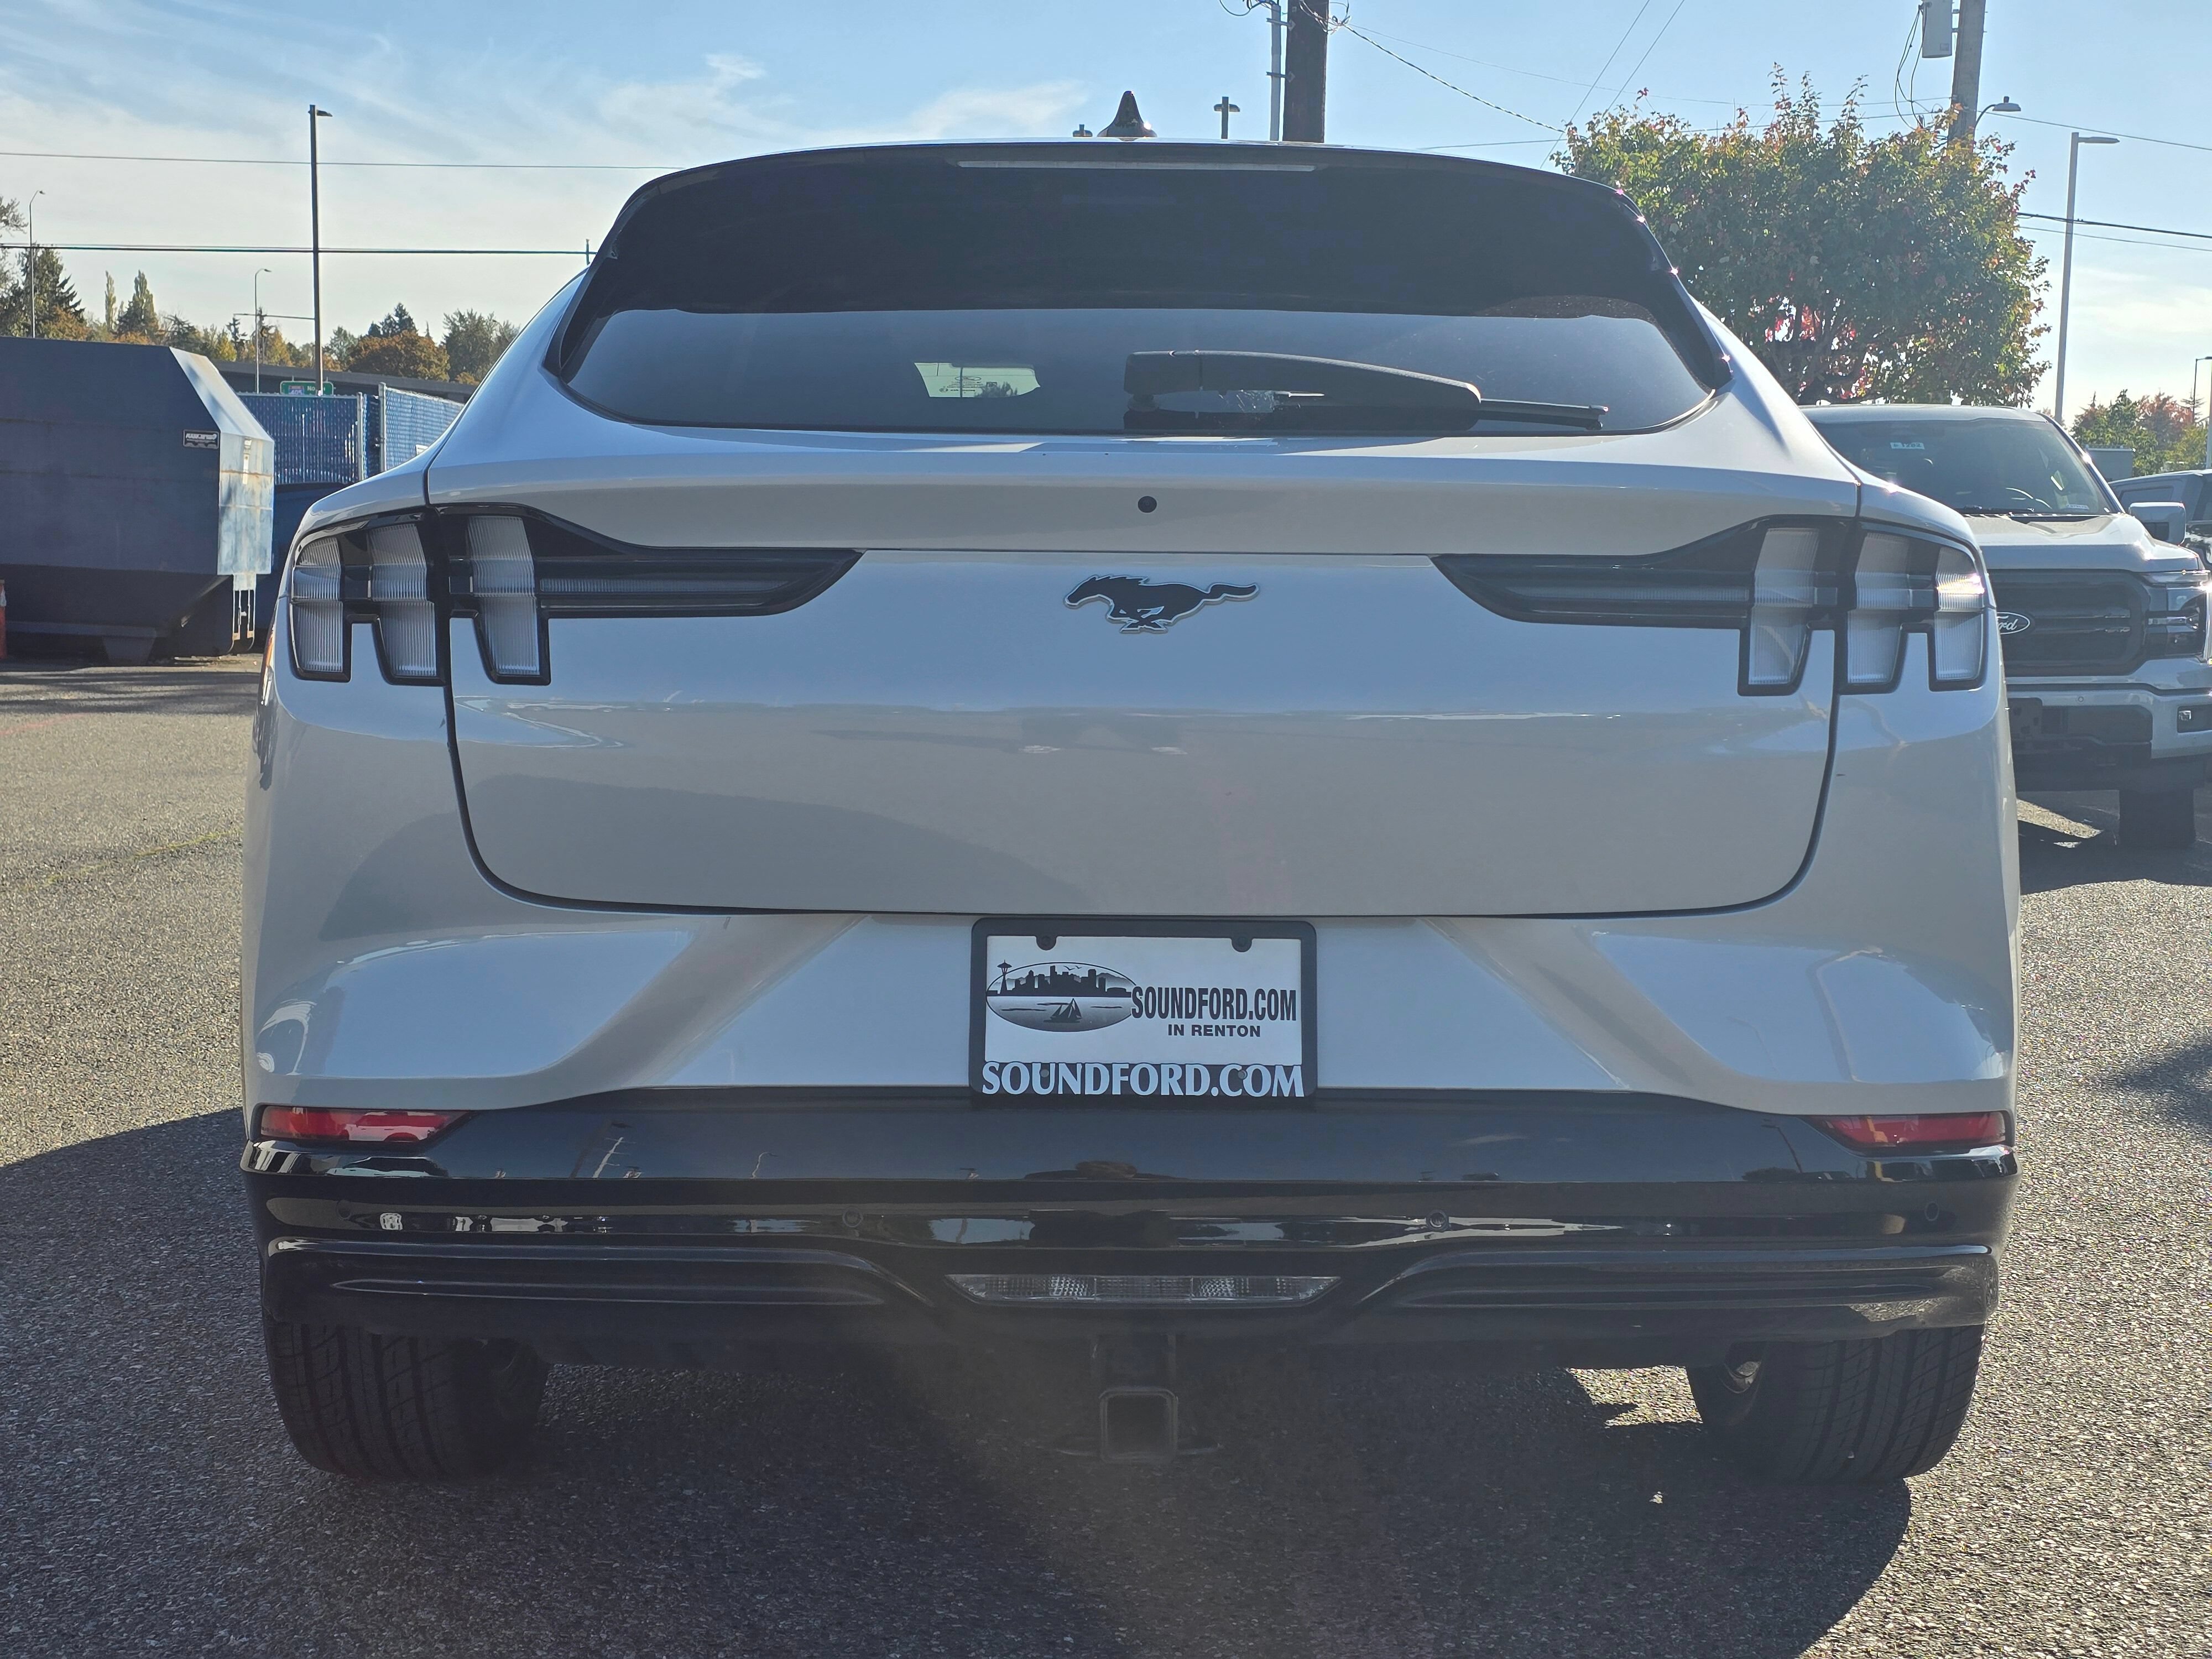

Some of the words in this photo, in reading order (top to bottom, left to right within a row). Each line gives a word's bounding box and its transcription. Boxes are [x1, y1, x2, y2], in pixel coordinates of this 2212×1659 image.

[1131, 986, 1296, 1021] SOUNDFORD.COM
[1167, 1024, 1184, 1036] IN
[1191, 1024, 1260, 1037] RENTON
[982, 1061, 1304, 1097] SOUNDFORD.COM
